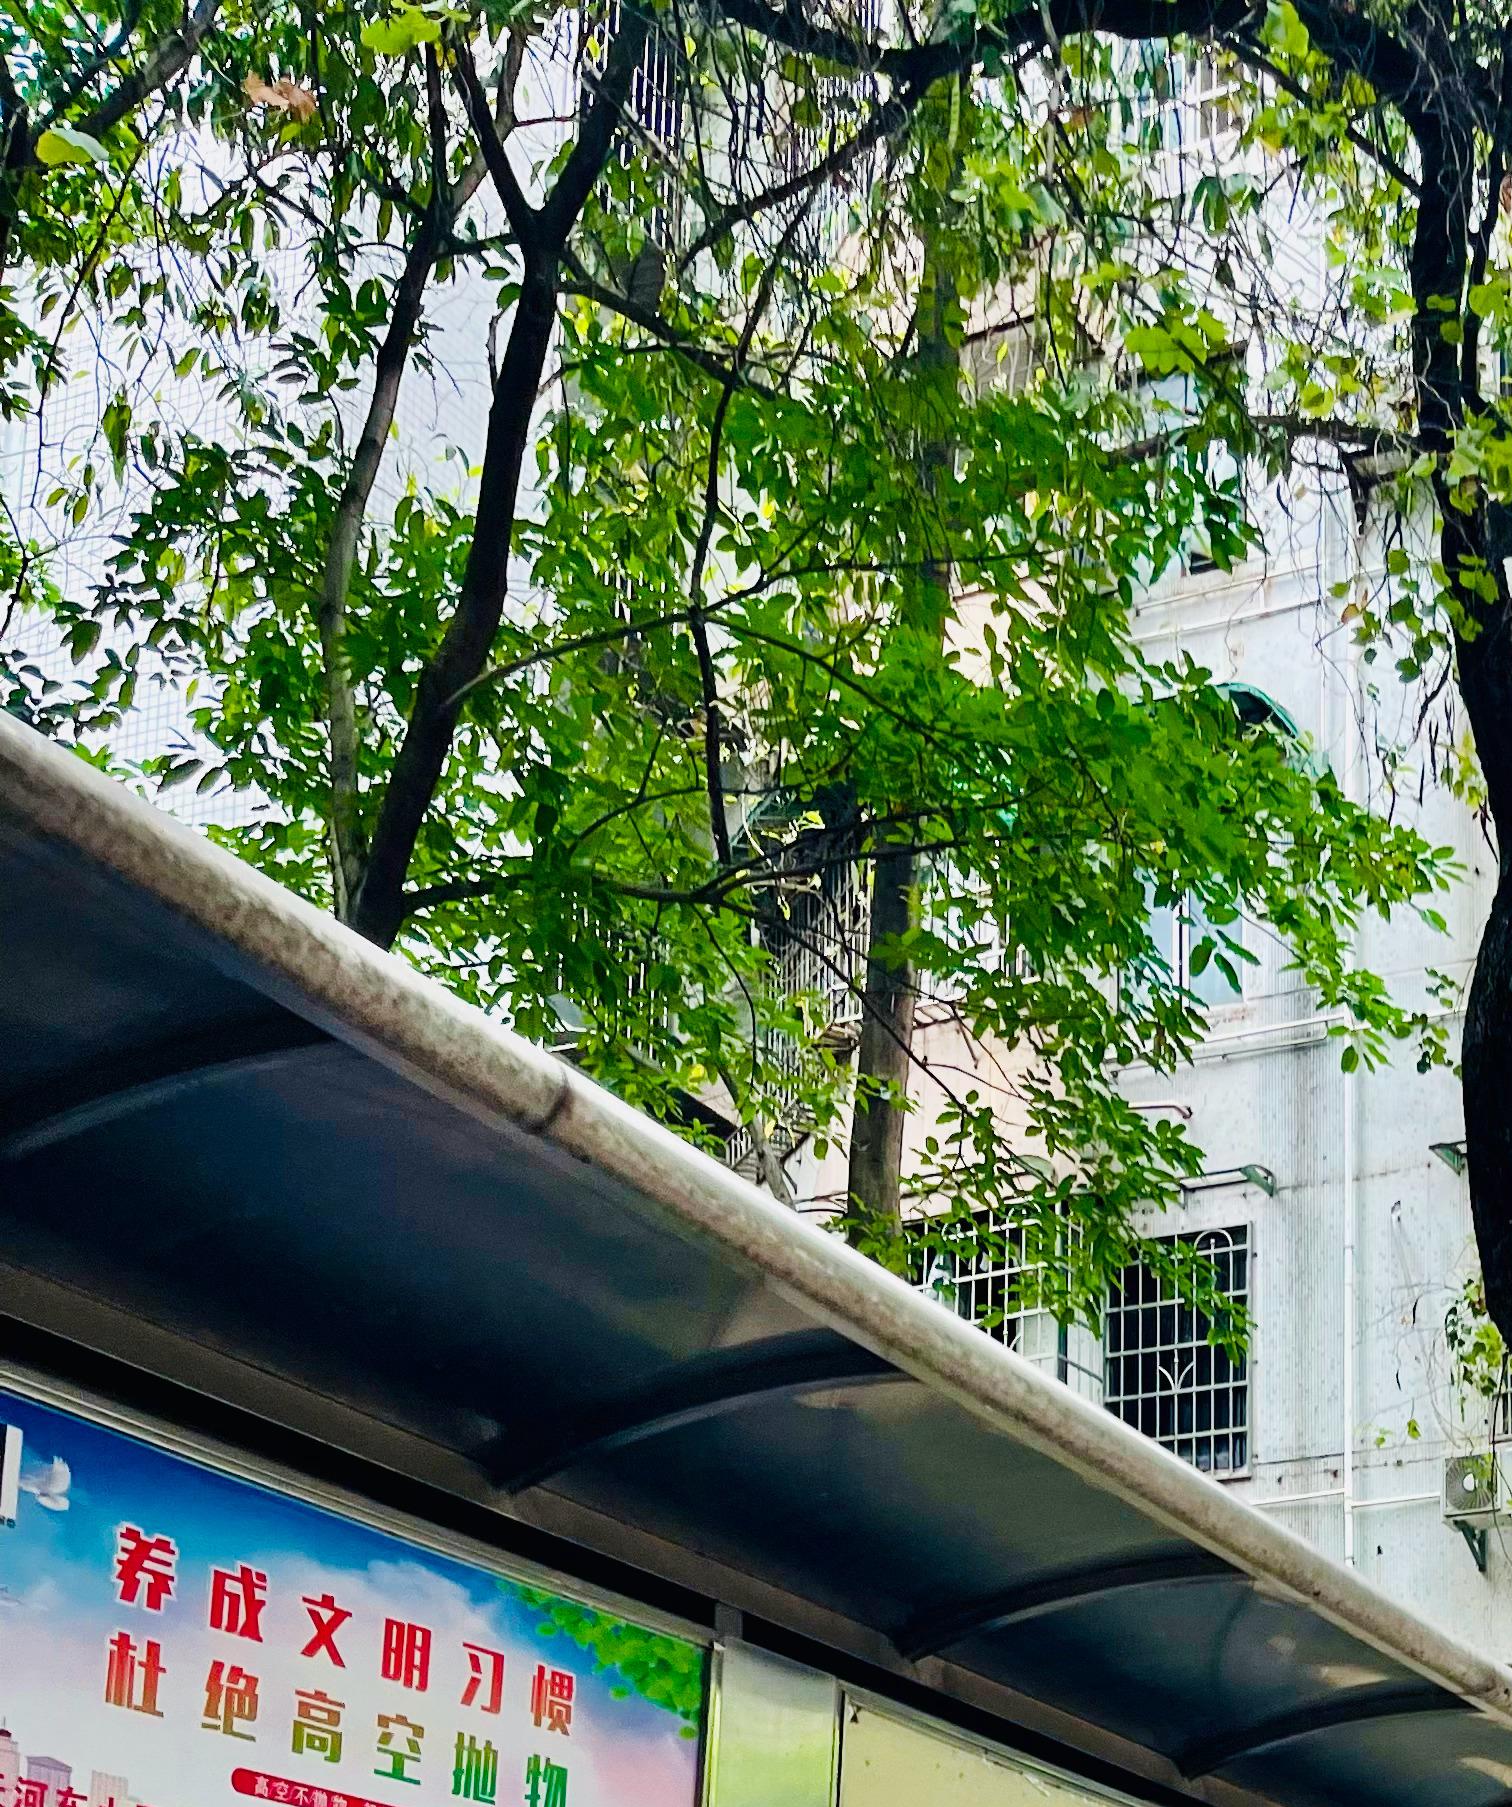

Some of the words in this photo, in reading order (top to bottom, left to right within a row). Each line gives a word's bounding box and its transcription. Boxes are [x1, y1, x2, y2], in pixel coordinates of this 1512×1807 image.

[114, 1526, 575, 1737] 养成文明习惯
